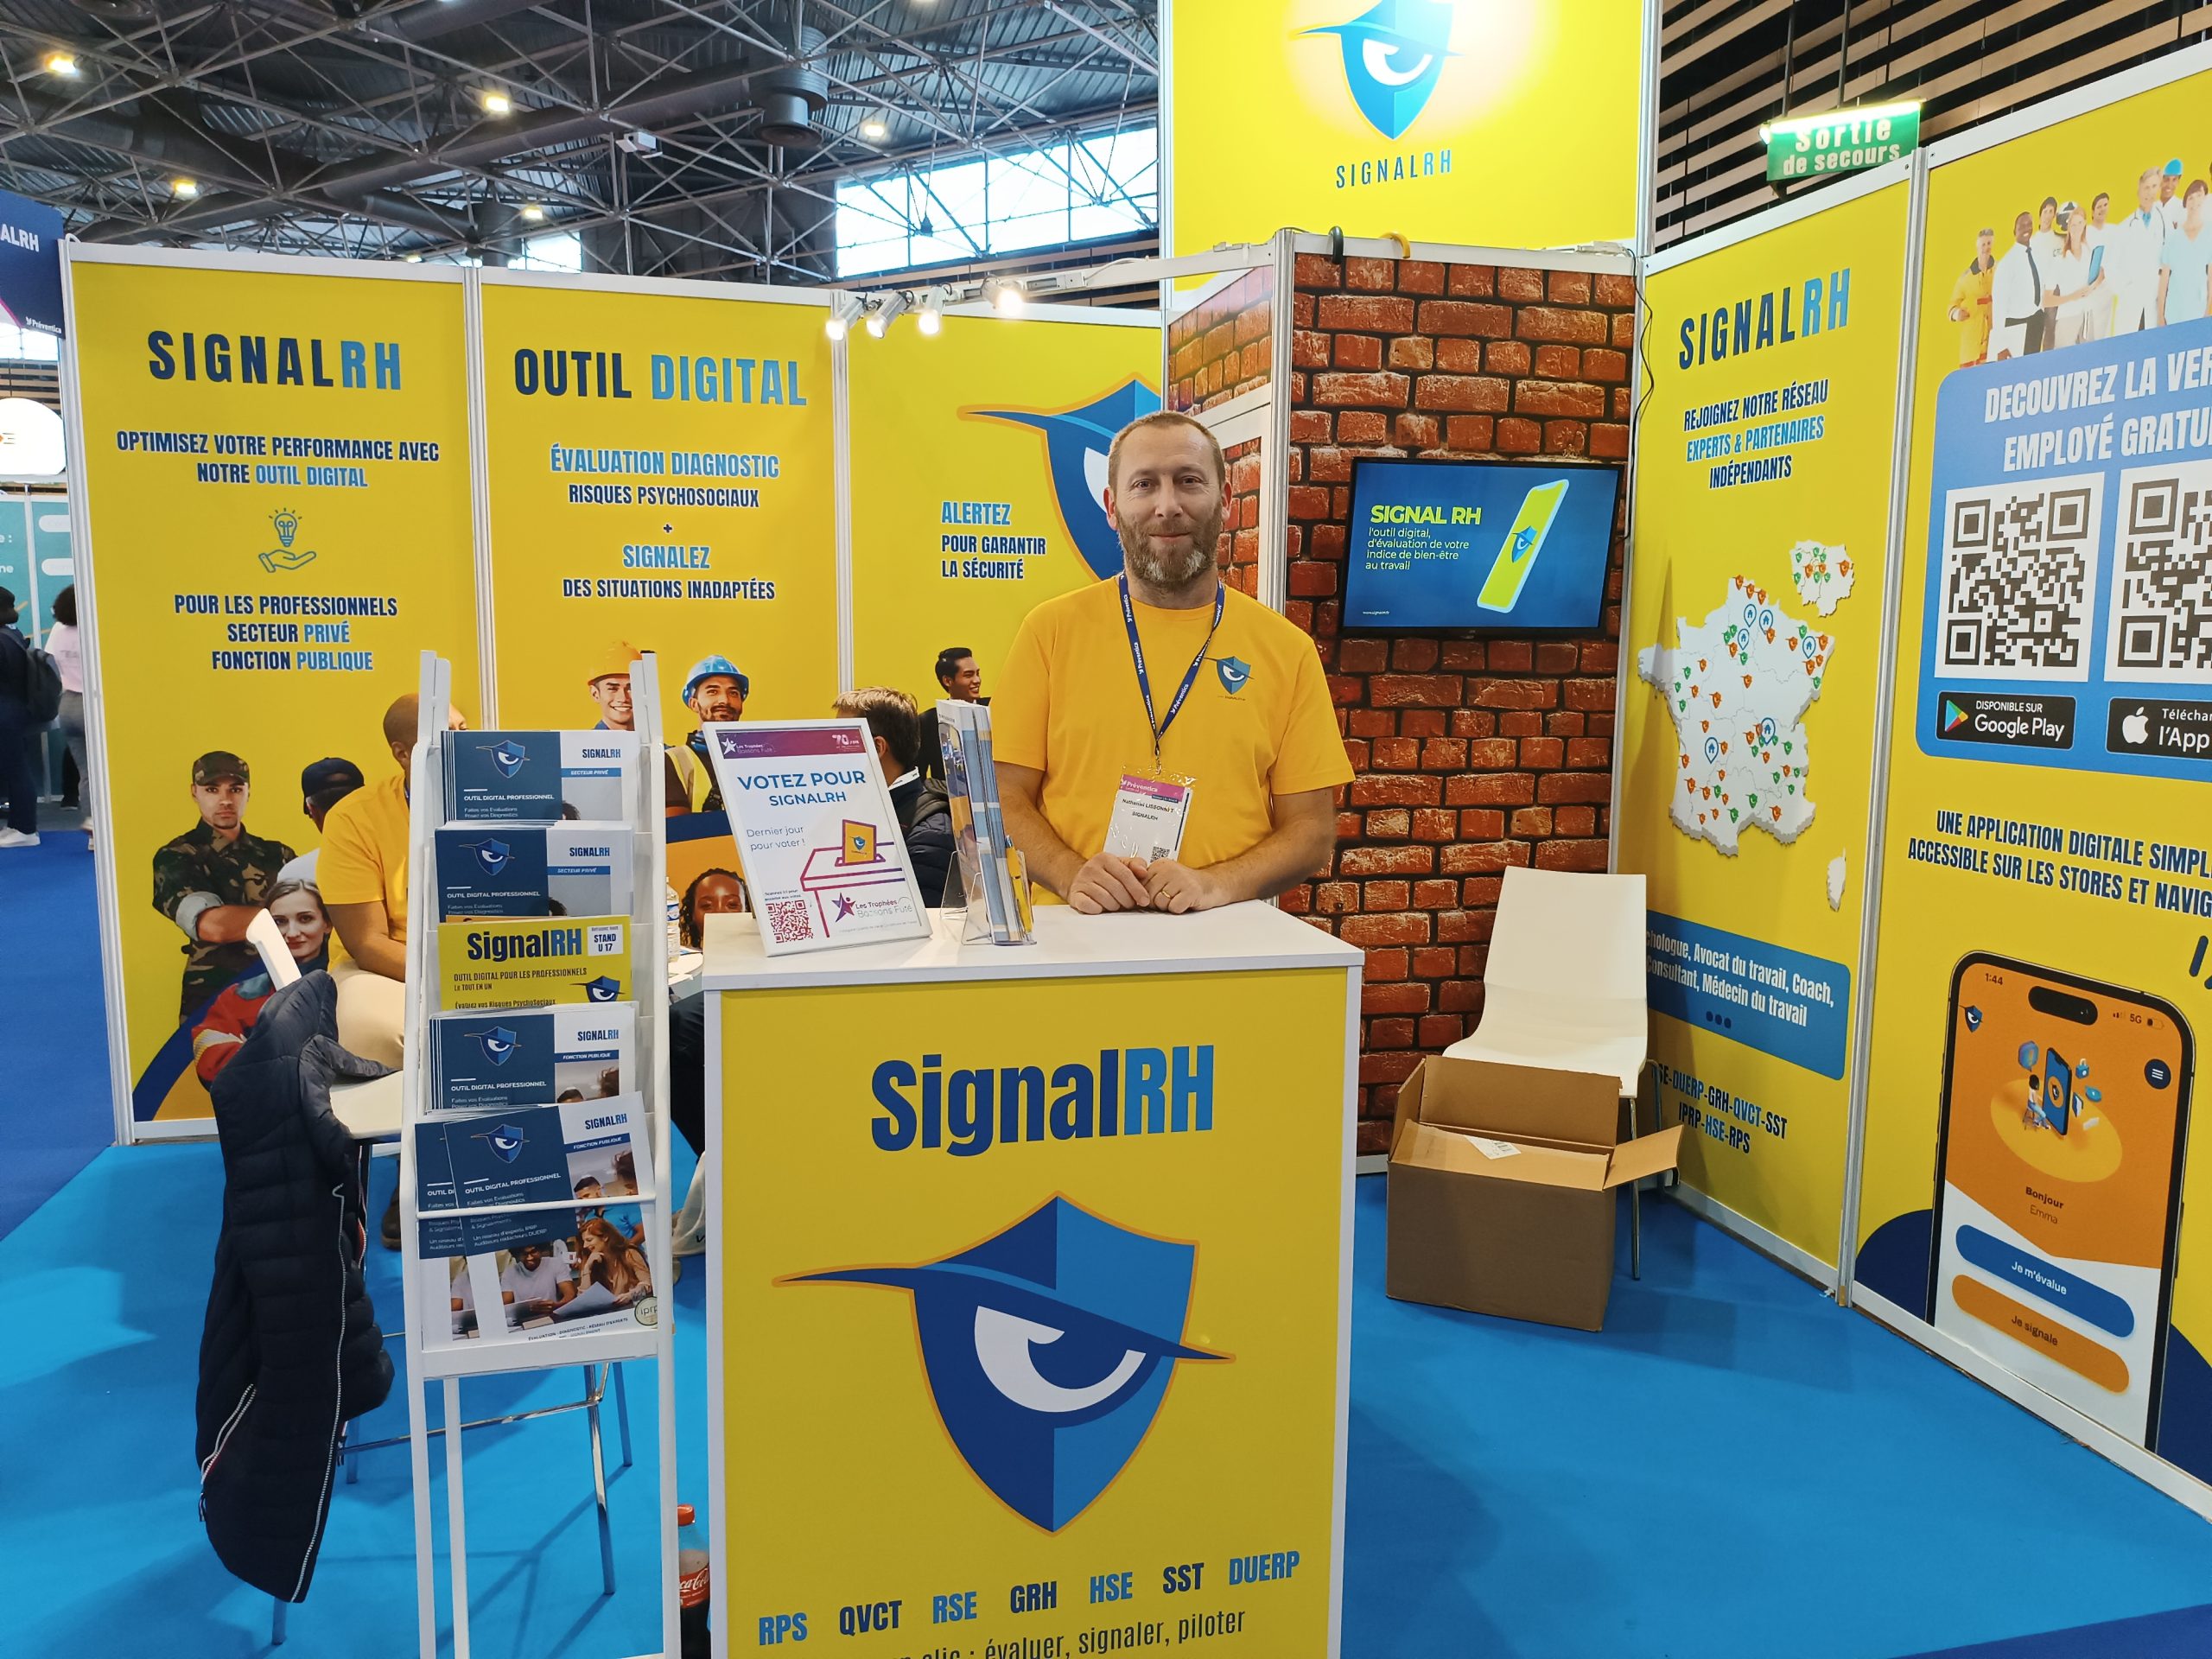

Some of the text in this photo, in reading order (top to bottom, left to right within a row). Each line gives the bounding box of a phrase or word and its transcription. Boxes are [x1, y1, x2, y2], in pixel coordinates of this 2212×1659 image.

[1795, 116, 1891, 152] Sortie
[1336, 149, 1452, 189] SIGNALRH
[1783, 144, 1901, 176] de secours
[1679, 268, 1851, 370] SIGNALRH
[148, 330, 402, 391] SIGNALRH
[514, 348, 808, 406] OUTIL DIGITAL
[1985, 364, 2119, 423] DECOUVREZ
[2124, 356, 2158, 400] LA
[1684, 379, 1829, 431] REJOIGNEZ NOTRE RÉSEAU
[117, 430, 440, 462] OPTIMISEZ VOTRE PERFORMANCE AVEC
[1686, 415, 1826, 462] EXPERTS & PARTENAIRES
[2003, 412, 2114, 473] EMPLOYÉ
[550, 442, 779, 478] ÉVALUATION DIAGNOSTIC
[1709, 454, 1793, 489] INDÉPENDANTS
[197, 464, 369, 487] NOTRE OUTIL DIGITAL
[569, 484, 760, 507] RISQUES PSYCHOSOCIAUX
[941, 501, 1011, 526] ALERTEZ
[1370, 505, 1482, 525] SIGNAL RH
[942, 534, 1046, 555] POUR GARANTIR
[1367, 538, 1469, 550] d'évaluation de votre
[1369, 527, 1431, 539] l'outil digital,
[622, 544, 711, 569] SIGNALEZ
[1365, 560, 1410, 570] au travail
[1366, 550, 1459, 561] indice de bien-être
[942, 557, 1025, 580] LA SÉCURITÉ
[563, 576, 775, 600] DES SITUATIONS INADAPTÉES
[175, 594, 397, 617] POUR LES PROFESSIONNELS
[227, 620, 350, 644] SECTEUR PRIVÉ
[213, 651, 373, 671] FONCTION PUBLIQUE
[1976, 701, 2044, 713] DISPONIBLE SUR
[1974, 714, 2065, 741] Google Play
[582, 748, 621, 759] SIGNALRH
[737, 770, 867, 790] VOTEZ POUR
[769, 791, 847, 806] SIGNALRH
[747, 825, 804, 837] Dernier jour
[569, 847, 611, 857] SIGNALRH
[750, 841, 773, 852] pour
[775, 839, 801, 849] voter
[1936, 810, 2212, 879] UNE APPLICATION DIGITALE SIMPL
[1908, 837, 1989, 874] ACCESSIBLE
[1993, 853, 2023, 880] SUR
[2026, 859, 2055, 887] LES
[2059, 865, 2123, 900] STORES
[2128, 876, 2150, 906] ET
[868, 899, 898, 908] Trophées
[467, 928, 582, 963] SignalRH
[594, 933, 617, 943] STAND
[598, 943, 613, 952] U 17
[454, 967, 588, 982] OUTIL DIGITAL POUR LES PROFESSIONNELS
[1694, 943, 1730, 972] Avocat
[1732, 955, 1746, 977] du
[1749, 959, 1789, 994] travail,
[1792, 973, 1834, 1008] Coach,
[1985, 972, 2005, 986] 1:44
[1647, 955, 1808, 1027] Consultant, Médecin du travail
[2129, 1013, 2143, 1025] 5G
[577, 1029, 620, 1042] SIGNALRH
[496, 1080, 547, 1089] PROFESSIONNEL
[870, 1044, 1215, 1157] SignalRH
[584, 1113, 628, 1130] SIGNALRH
[485, 1182, 510, 1191] DIGITAL
[510, 1173, 562, 1186] PROFESSIONNEL
[2024, 1185, 2064, 1210] Bonjour
[2029, 1205, 2059, 1225] Emma
[2011, 1260, 2068, 1296] Je m'évalue
[2011, 1314, 2059, 1348] Je signale
[758, 1550, 1300, 1646] RPS QVCT RSE GRH HSE SST DUERP
[1078, 1622, 1170, 1655] signaler,
[1179, 1611, 1245, 1644] piloter
